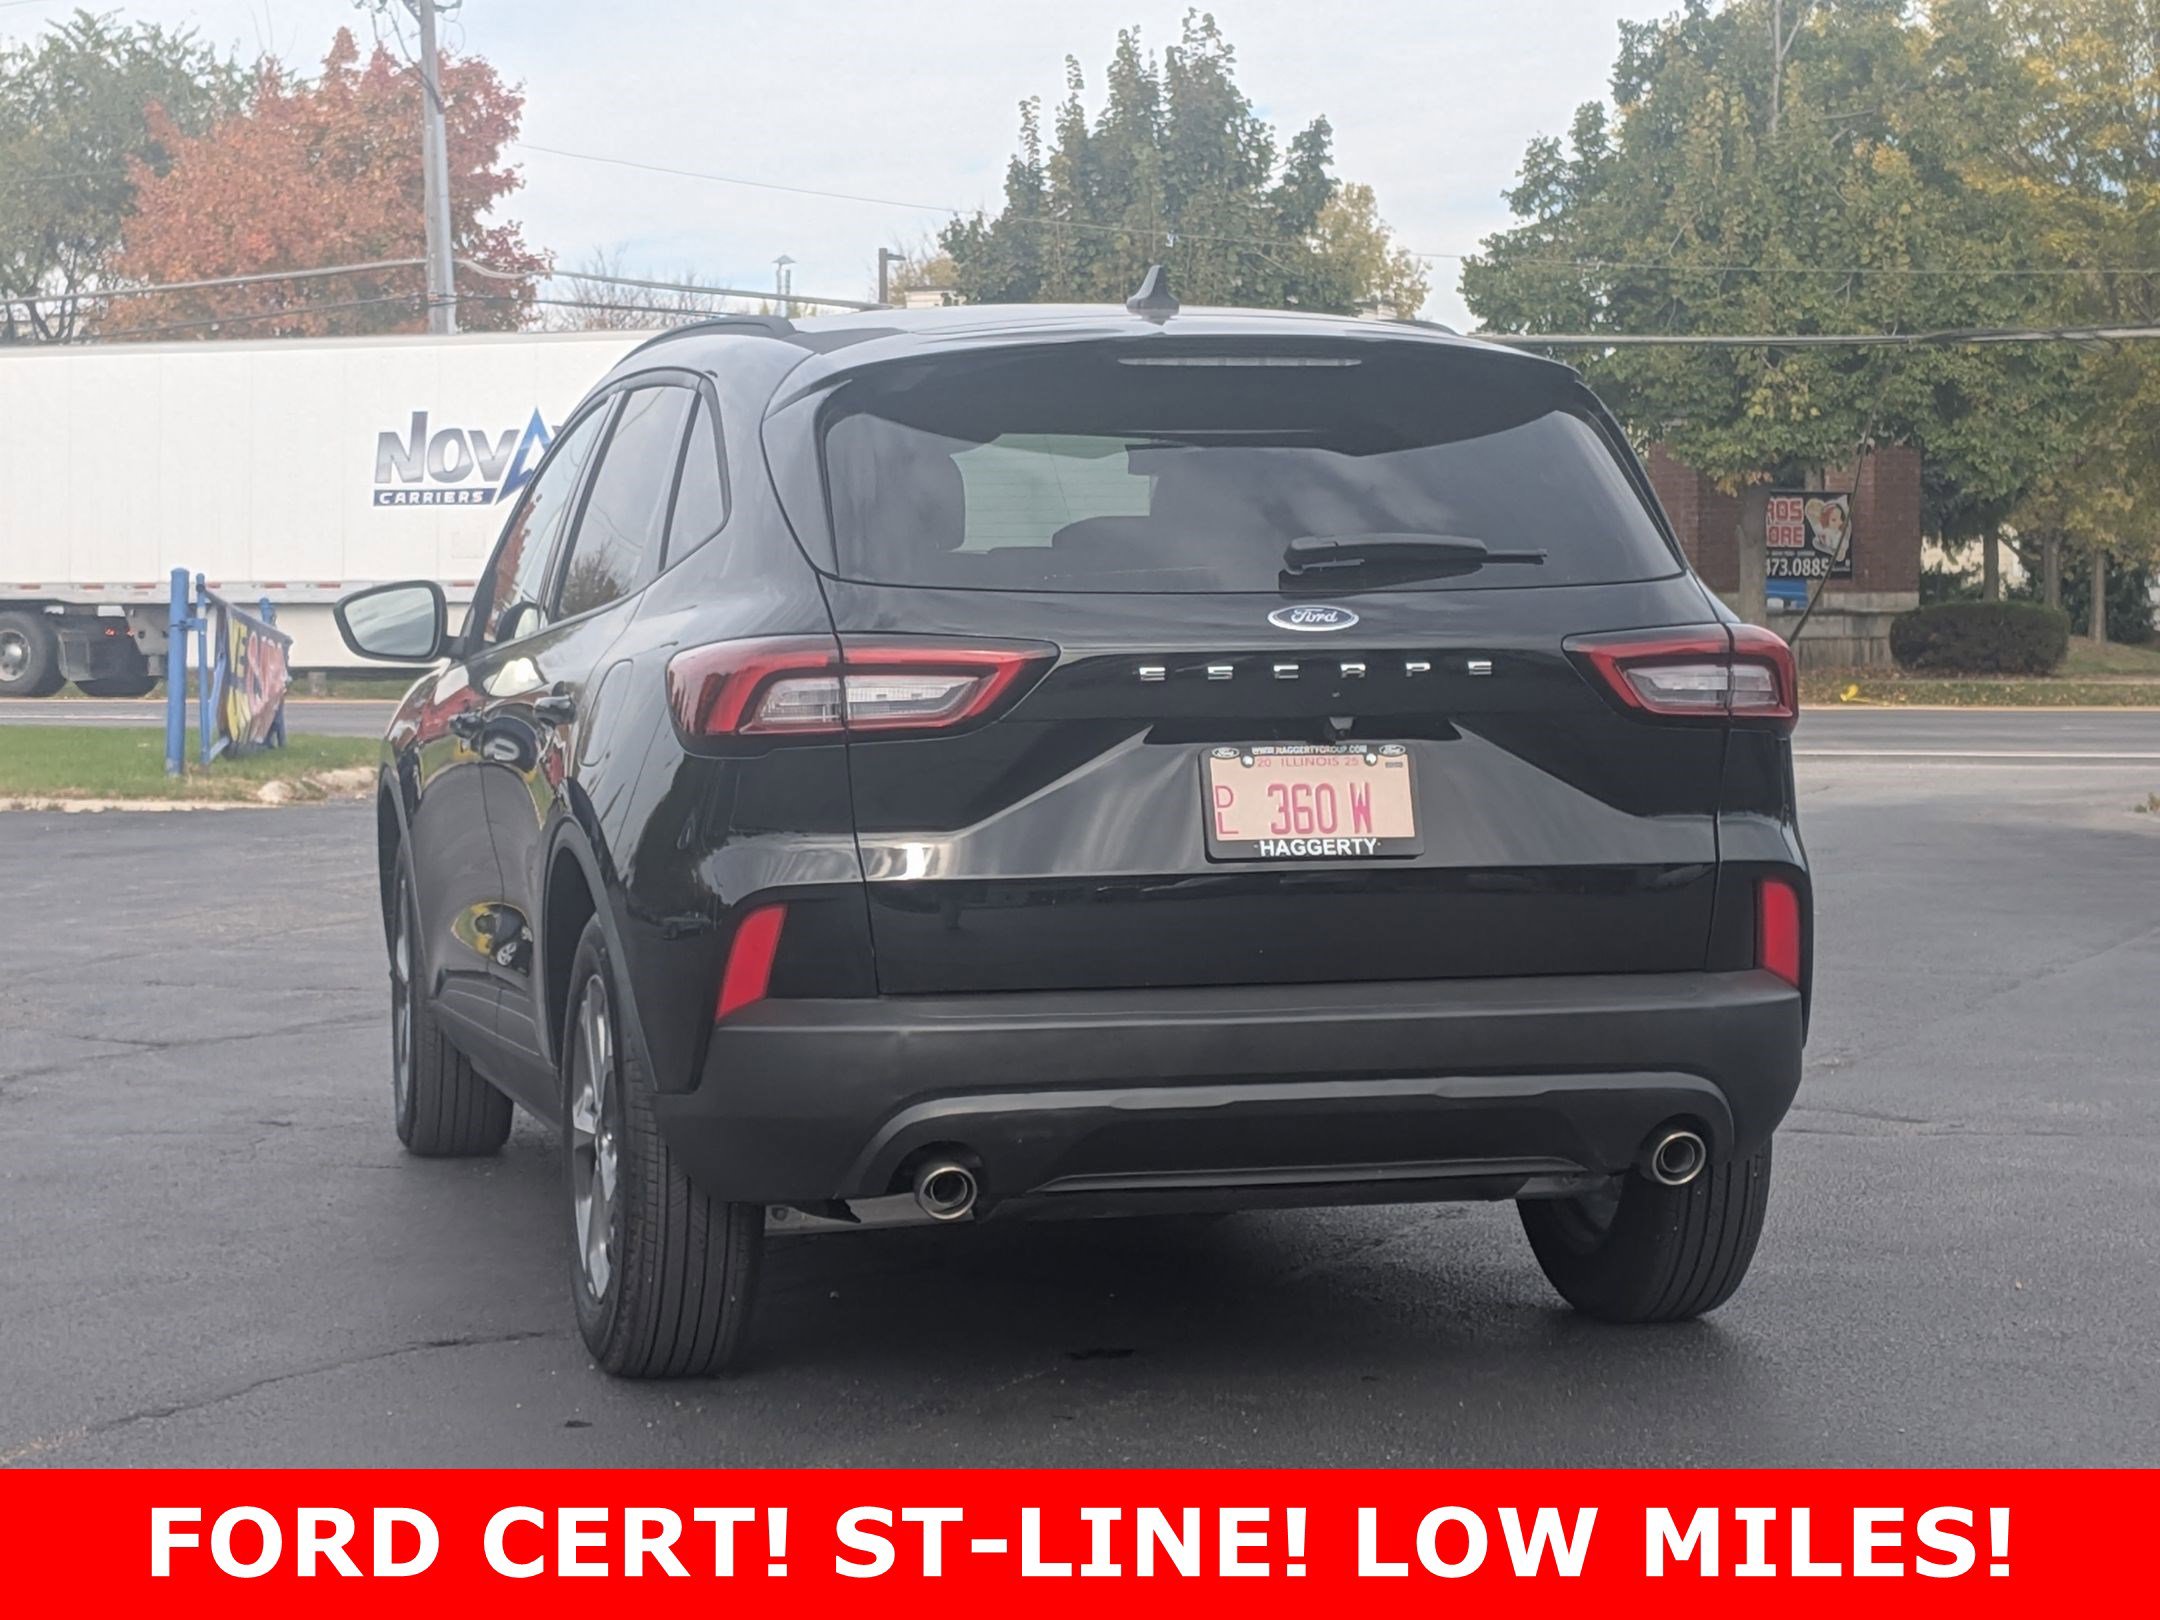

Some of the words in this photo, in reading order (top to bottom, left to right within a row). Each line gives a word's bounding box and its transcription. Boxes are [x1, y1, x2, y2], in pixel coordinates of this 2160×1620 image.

[374, 405, 564, 505] NOVA
[379, 490, 484, 505] CARRIERS
[1289, 607, 1338, 624] Ford
[1138, 660, 1493, 681] ESCAPE
[1257, 758, 1272, 768] 20
[1280, 757, 1340, 768] ILLINOIS
[1215, 785, 1234, 808] D
[1267, 783, 1338, 834] 360
[1349, 782, 1373, 833] W
[1217, 812, 1239, 835] L
[1259, 838, 1377, 857] HAGGERTY
